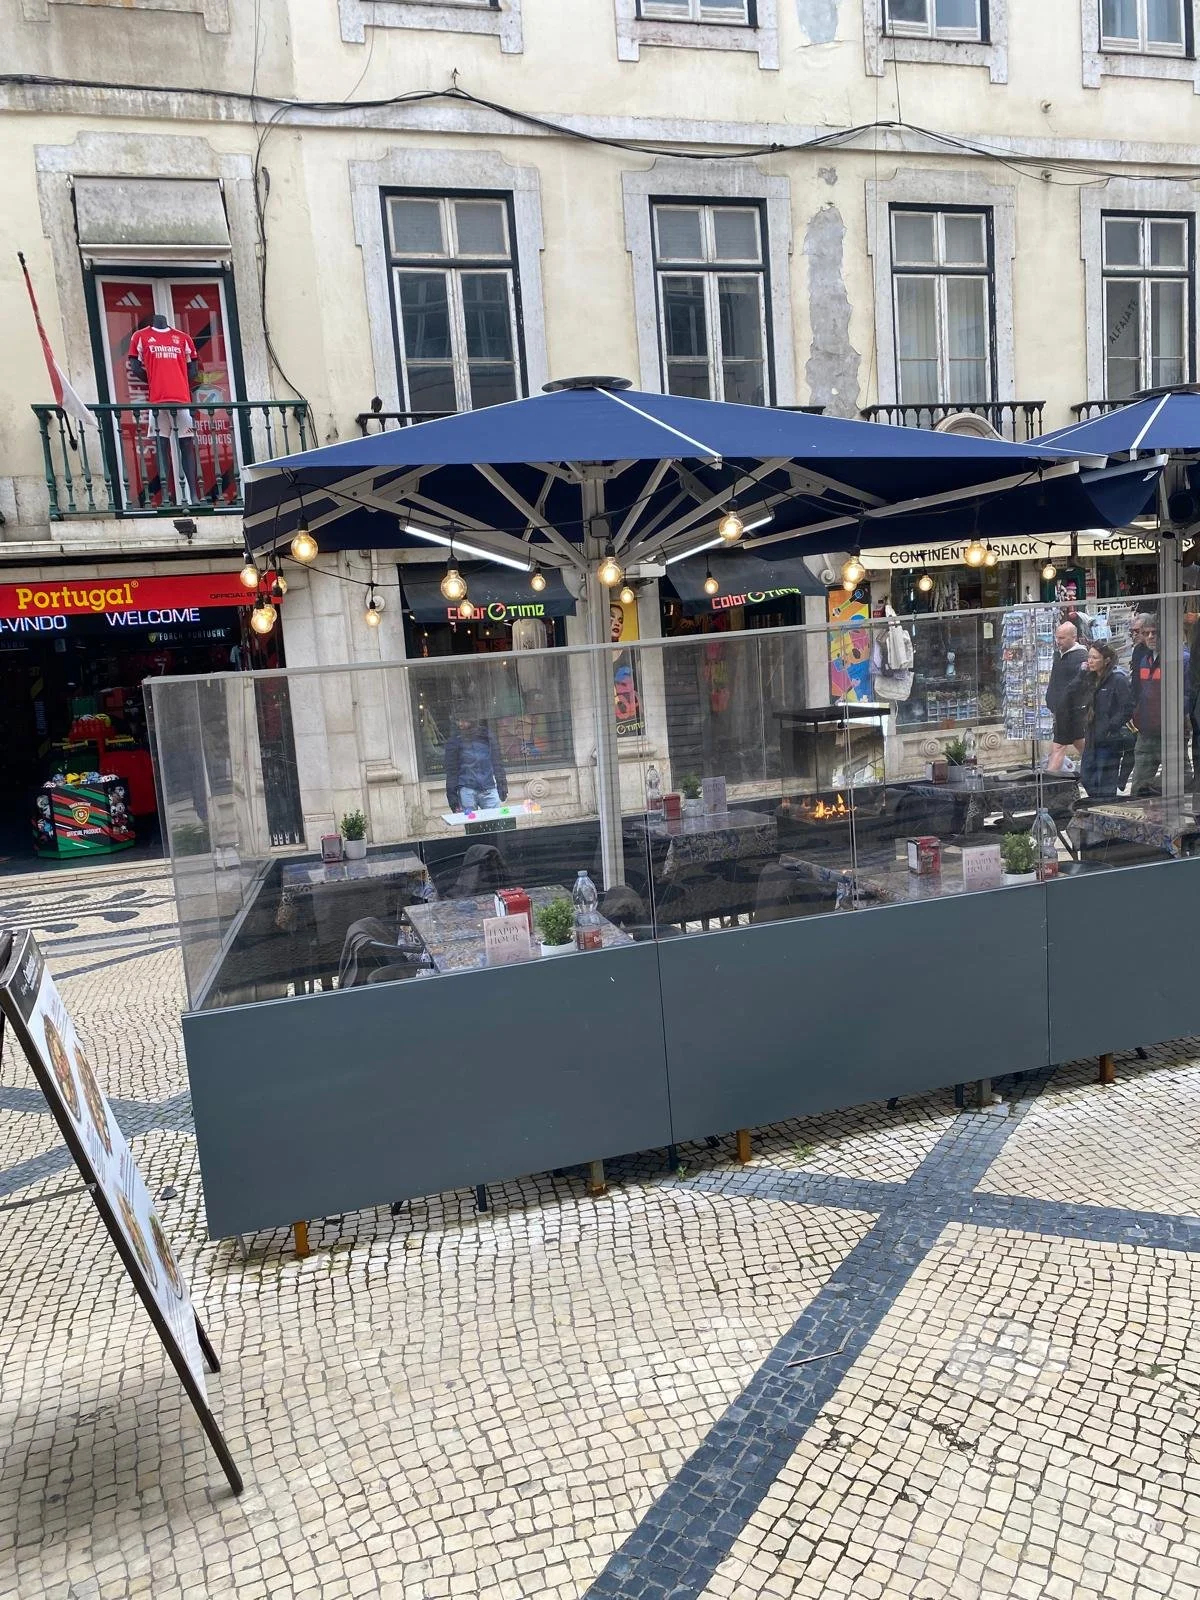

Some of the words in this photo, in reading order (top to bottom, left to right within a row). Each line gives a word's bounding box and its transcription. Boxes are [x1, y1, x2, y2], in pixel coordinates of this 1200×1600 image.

[148, 345, 182, 354] Emirates
[993, 542, 1039, 557] SNACK
[209, 591, 246, 600] OFFICIAL
[712, 593, 747, 610] color
[0, 615, 67, 632] -VINDO
[105, 608, 201, 627] WELCOME
[489, 926, 519, 937] HAPPY
[490, 934, 519, 945] HOUR
